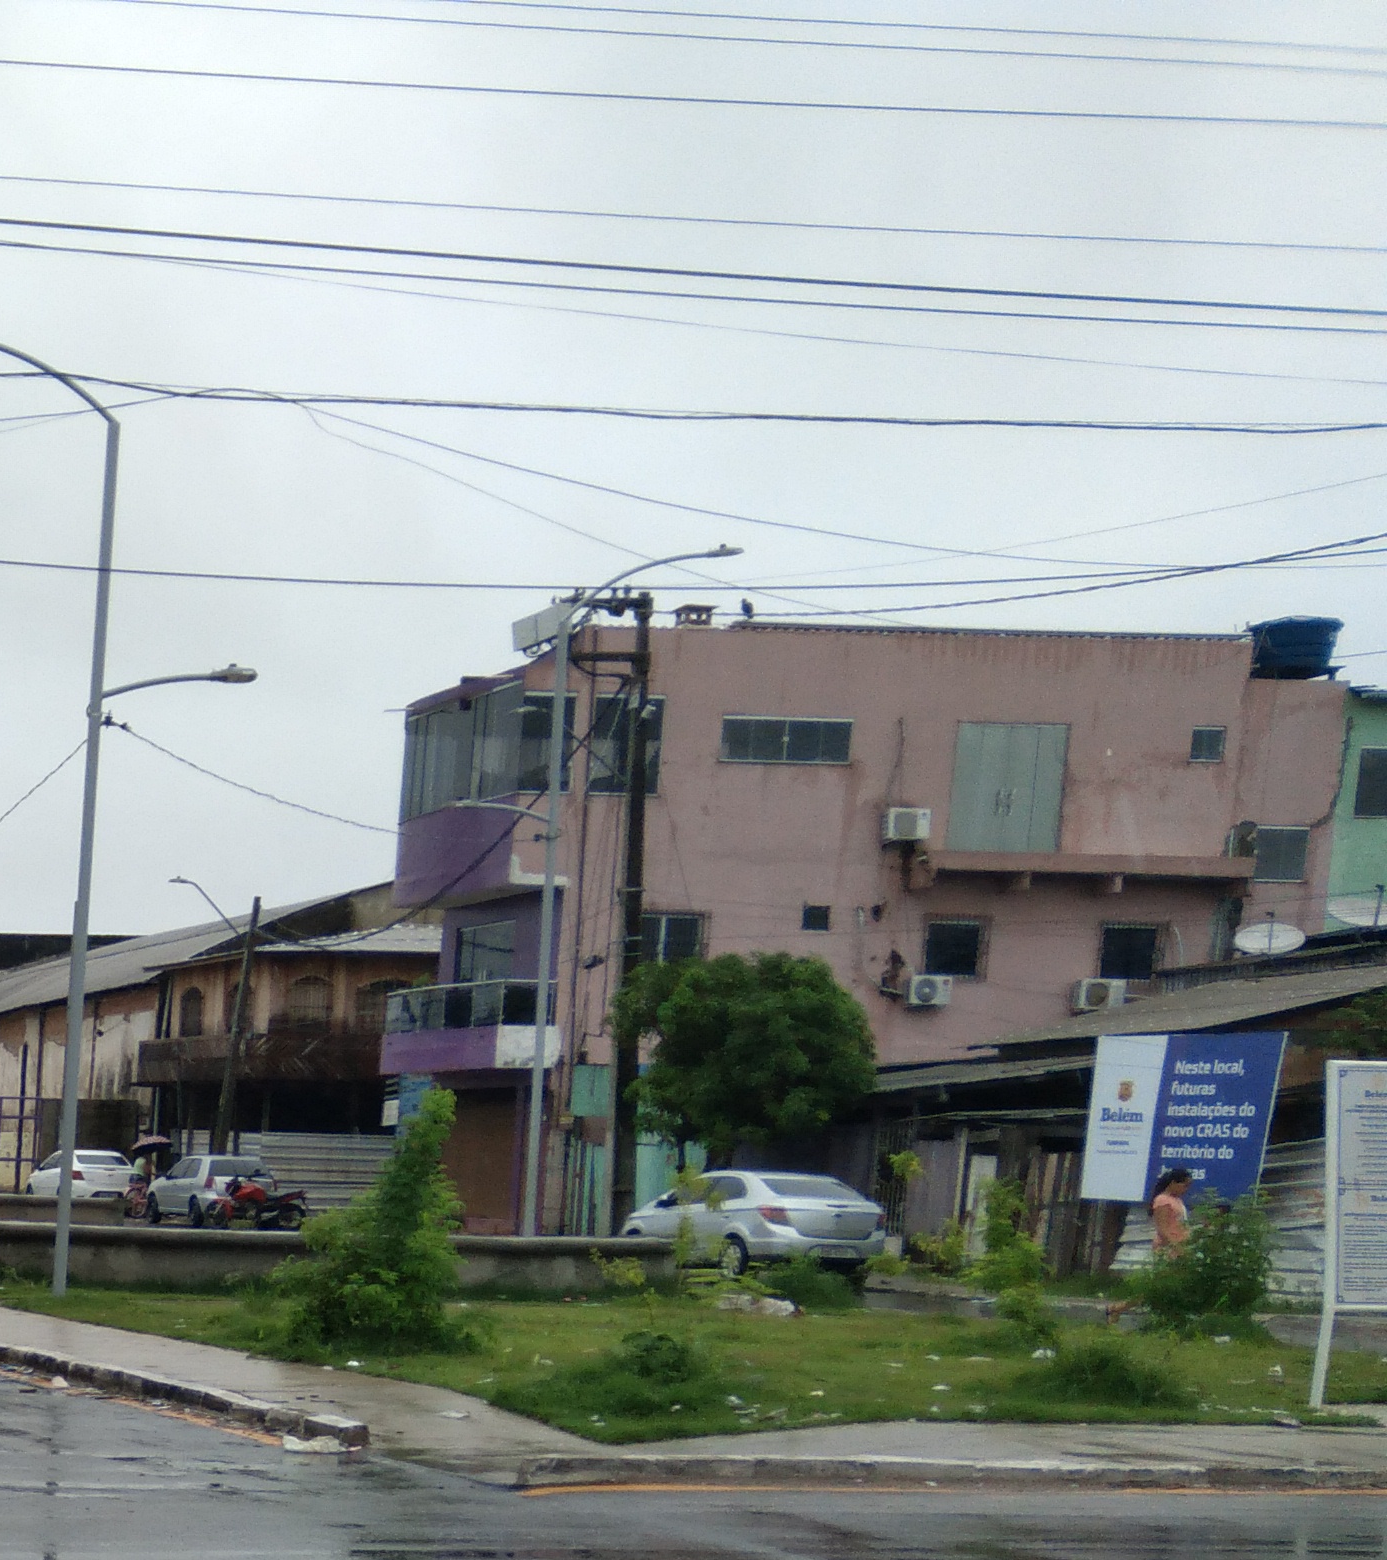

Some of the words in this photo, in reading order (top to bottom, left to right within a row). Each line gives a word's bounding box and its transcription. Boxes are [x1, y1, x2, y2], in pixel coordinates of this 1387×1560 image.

[1175, 1059, 1211, 1074] Neste
[1213, 1059, 1245, 1076] local,
[1171, 1081, 1216, 1095] futuras
[1100, 1107, 1144, 1123] Belém
[1167, 1101, 1237, 1120] instalações
[1239, 1102, 1255, 1116] do
[1164, 1125, 1194, 1137] novo
[1196, 1123, 1231, 1138] CRAS
[1233, 1124, 1249, 1138] do
[1161, 1144, 1215, 1159] território
[1217, 1145, 1234, 1159] do
